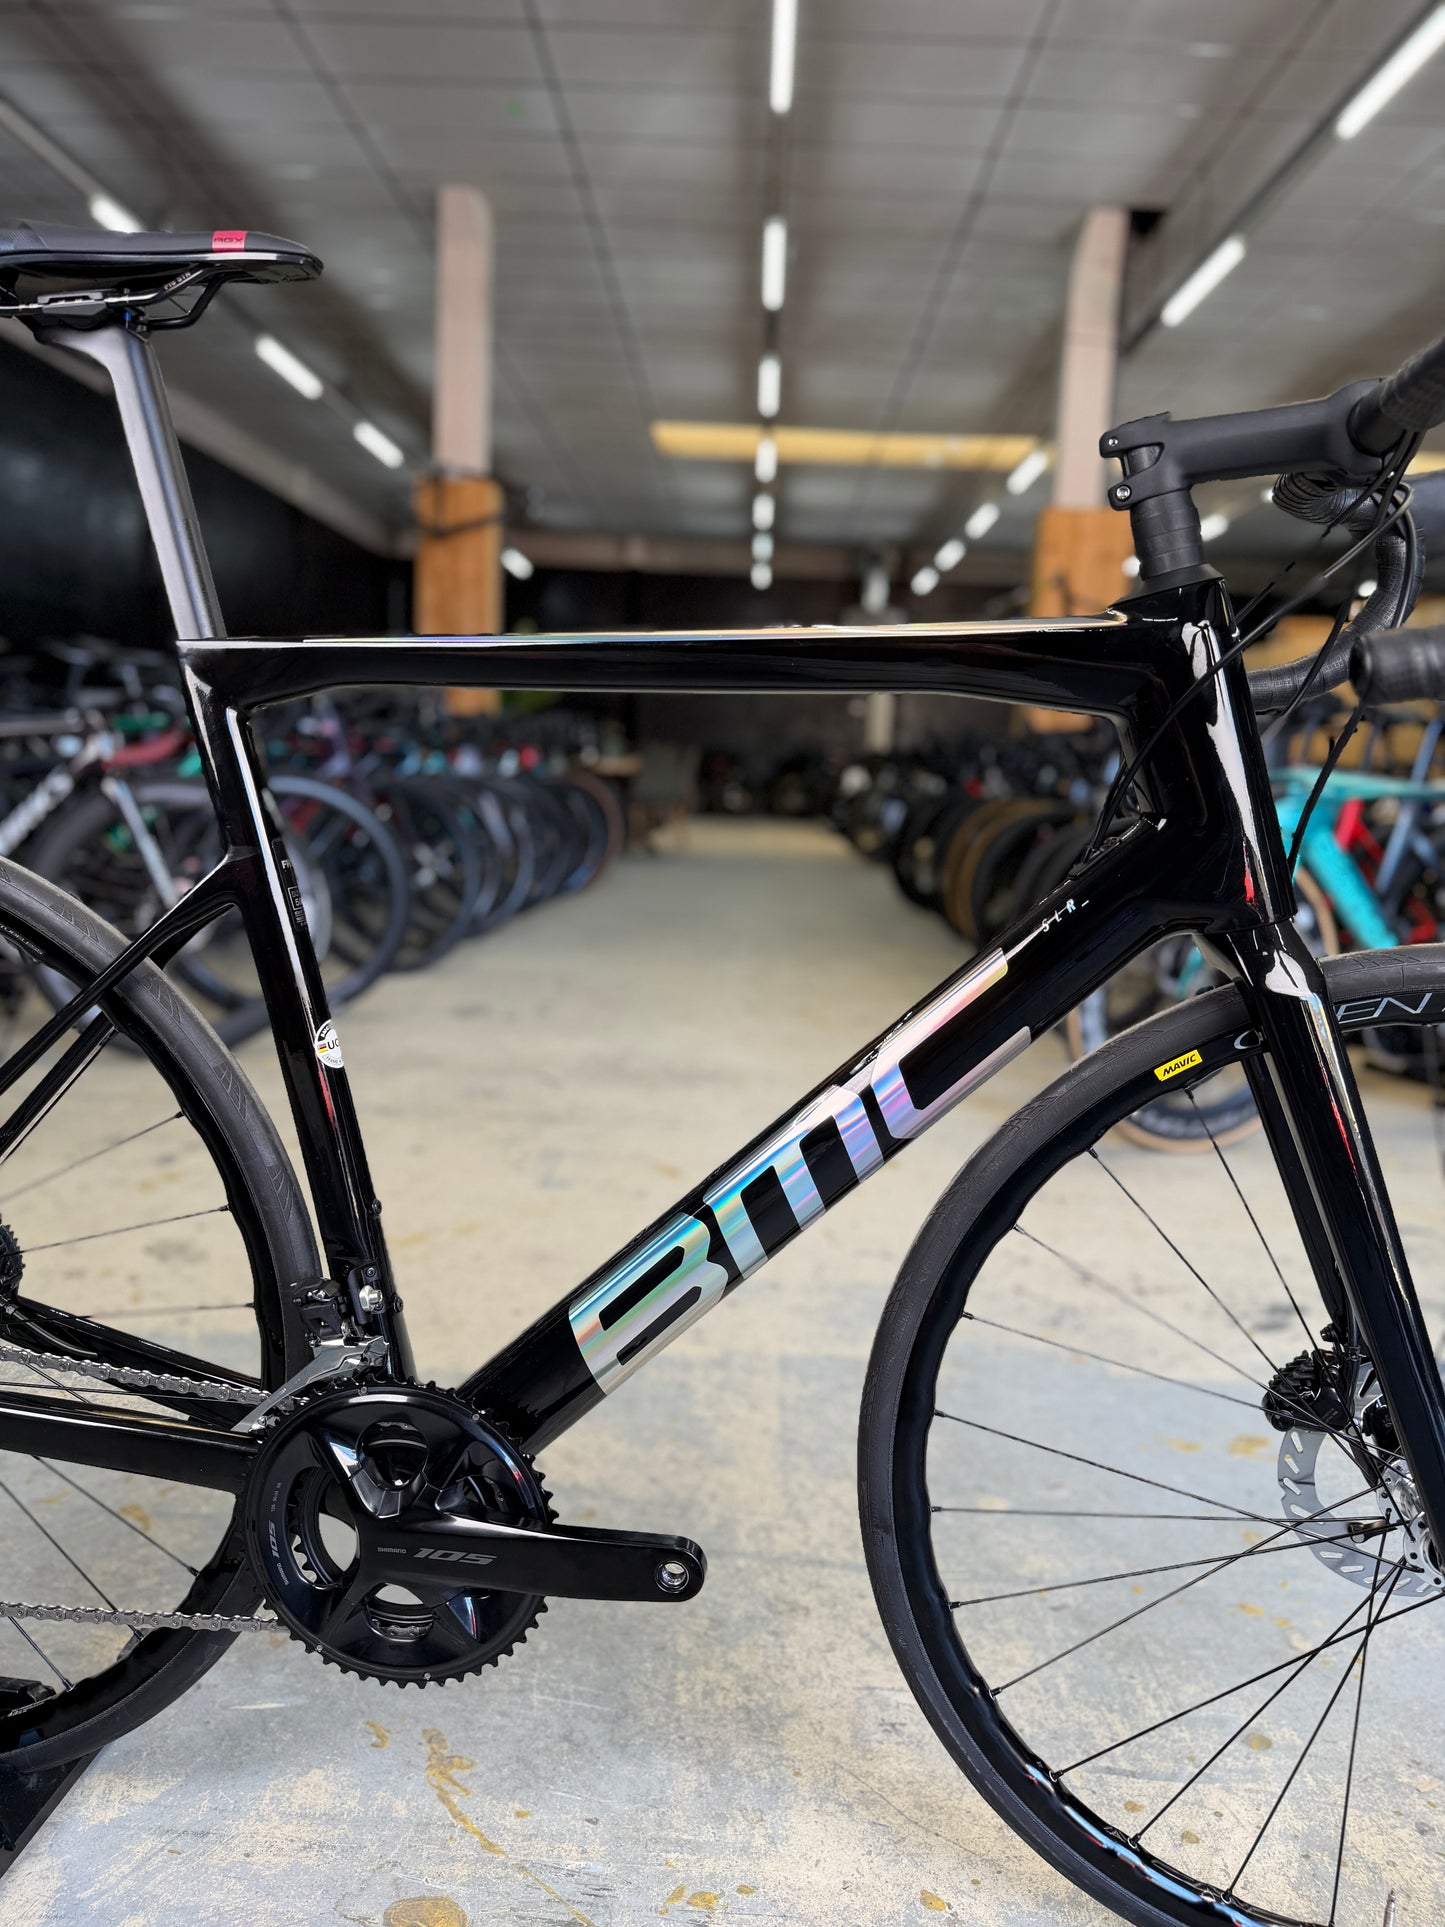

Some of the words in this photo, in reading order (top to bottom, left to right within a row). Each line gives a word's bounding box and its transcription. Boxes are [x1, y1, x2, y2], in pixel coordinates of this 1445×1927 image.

[1163, 1053, 1196, 1077] MAVIC
[568, 946, 1032, 1395] BMC
[268, 1519, 281, 1559] 105
[377, 1546, 407, 1555] SHIMANO
[414, 1547, 498, 1566] 105
